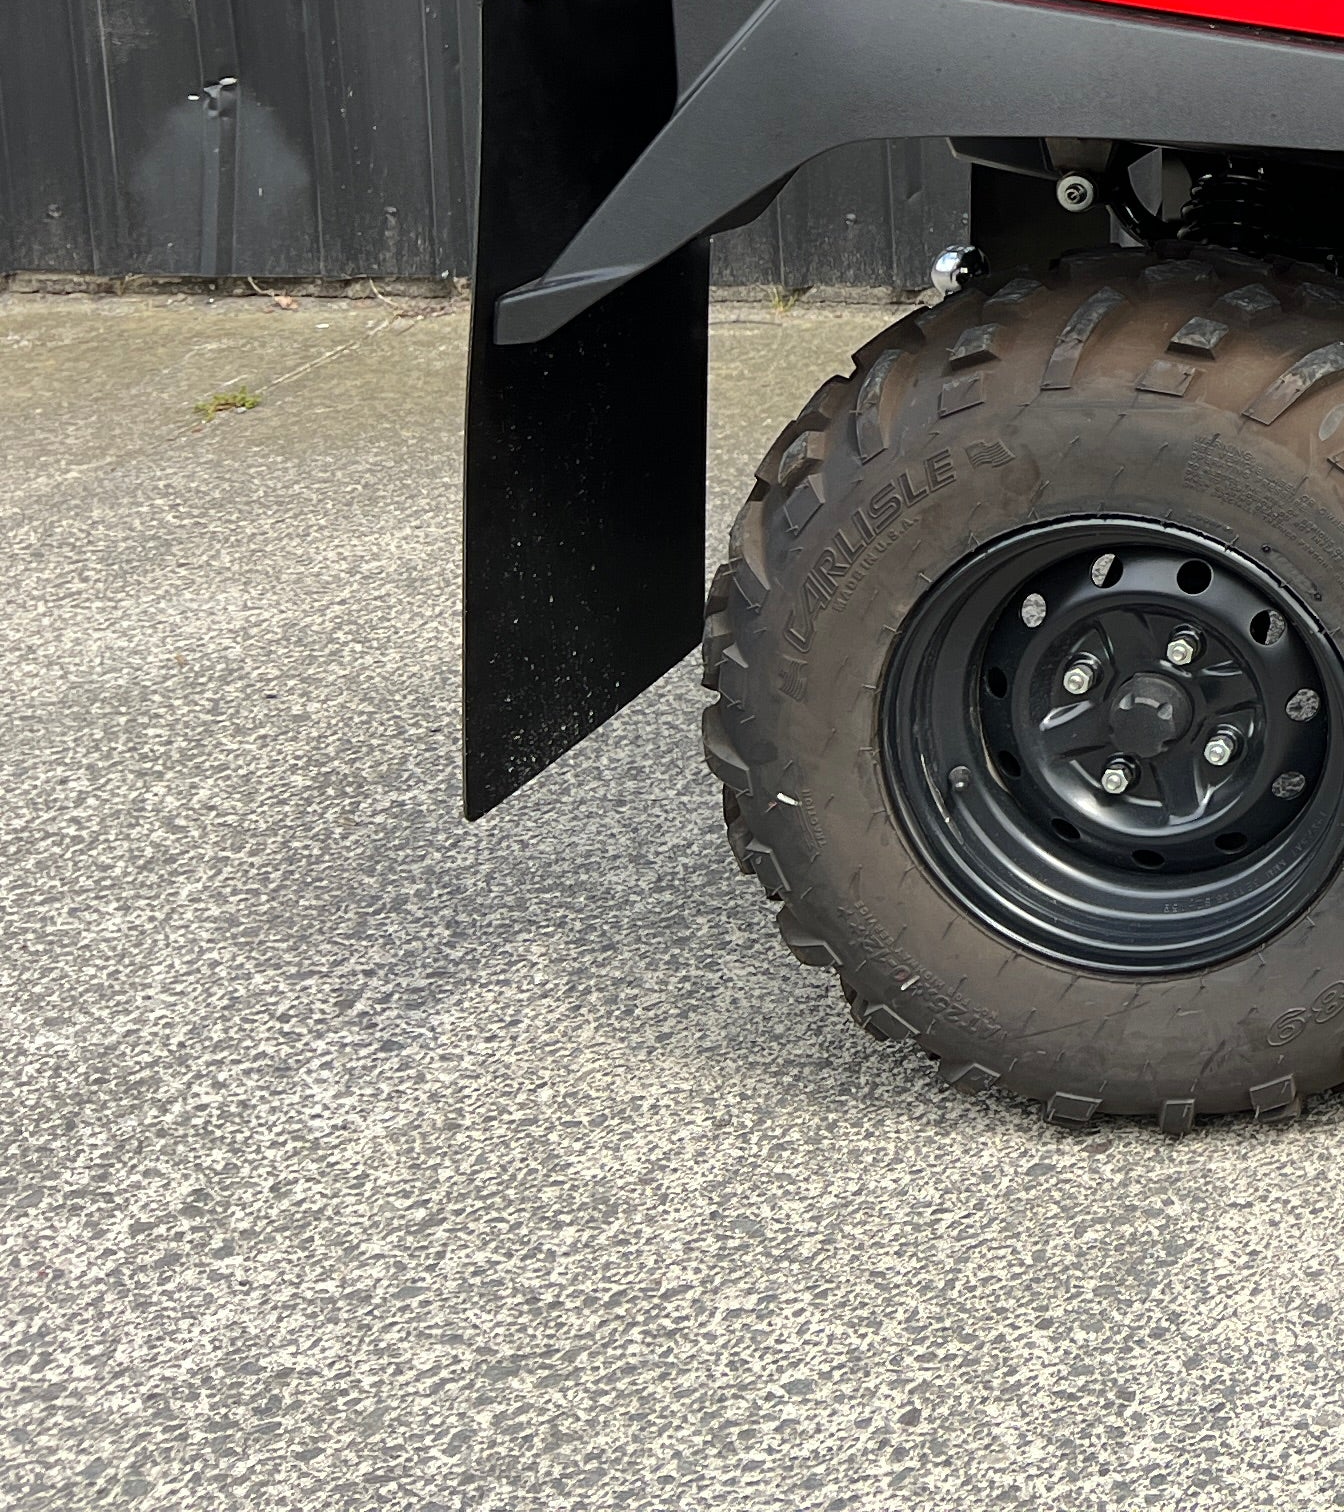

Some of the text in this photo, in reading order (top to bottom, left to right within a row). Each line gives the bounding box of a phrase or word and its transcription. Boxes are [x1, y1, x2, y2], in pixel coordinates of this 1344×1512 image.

[783, 448, 957, 653] CARLISLE
[833, 568, 864, 613] MADE
[861, 550, 878, 572] IN
